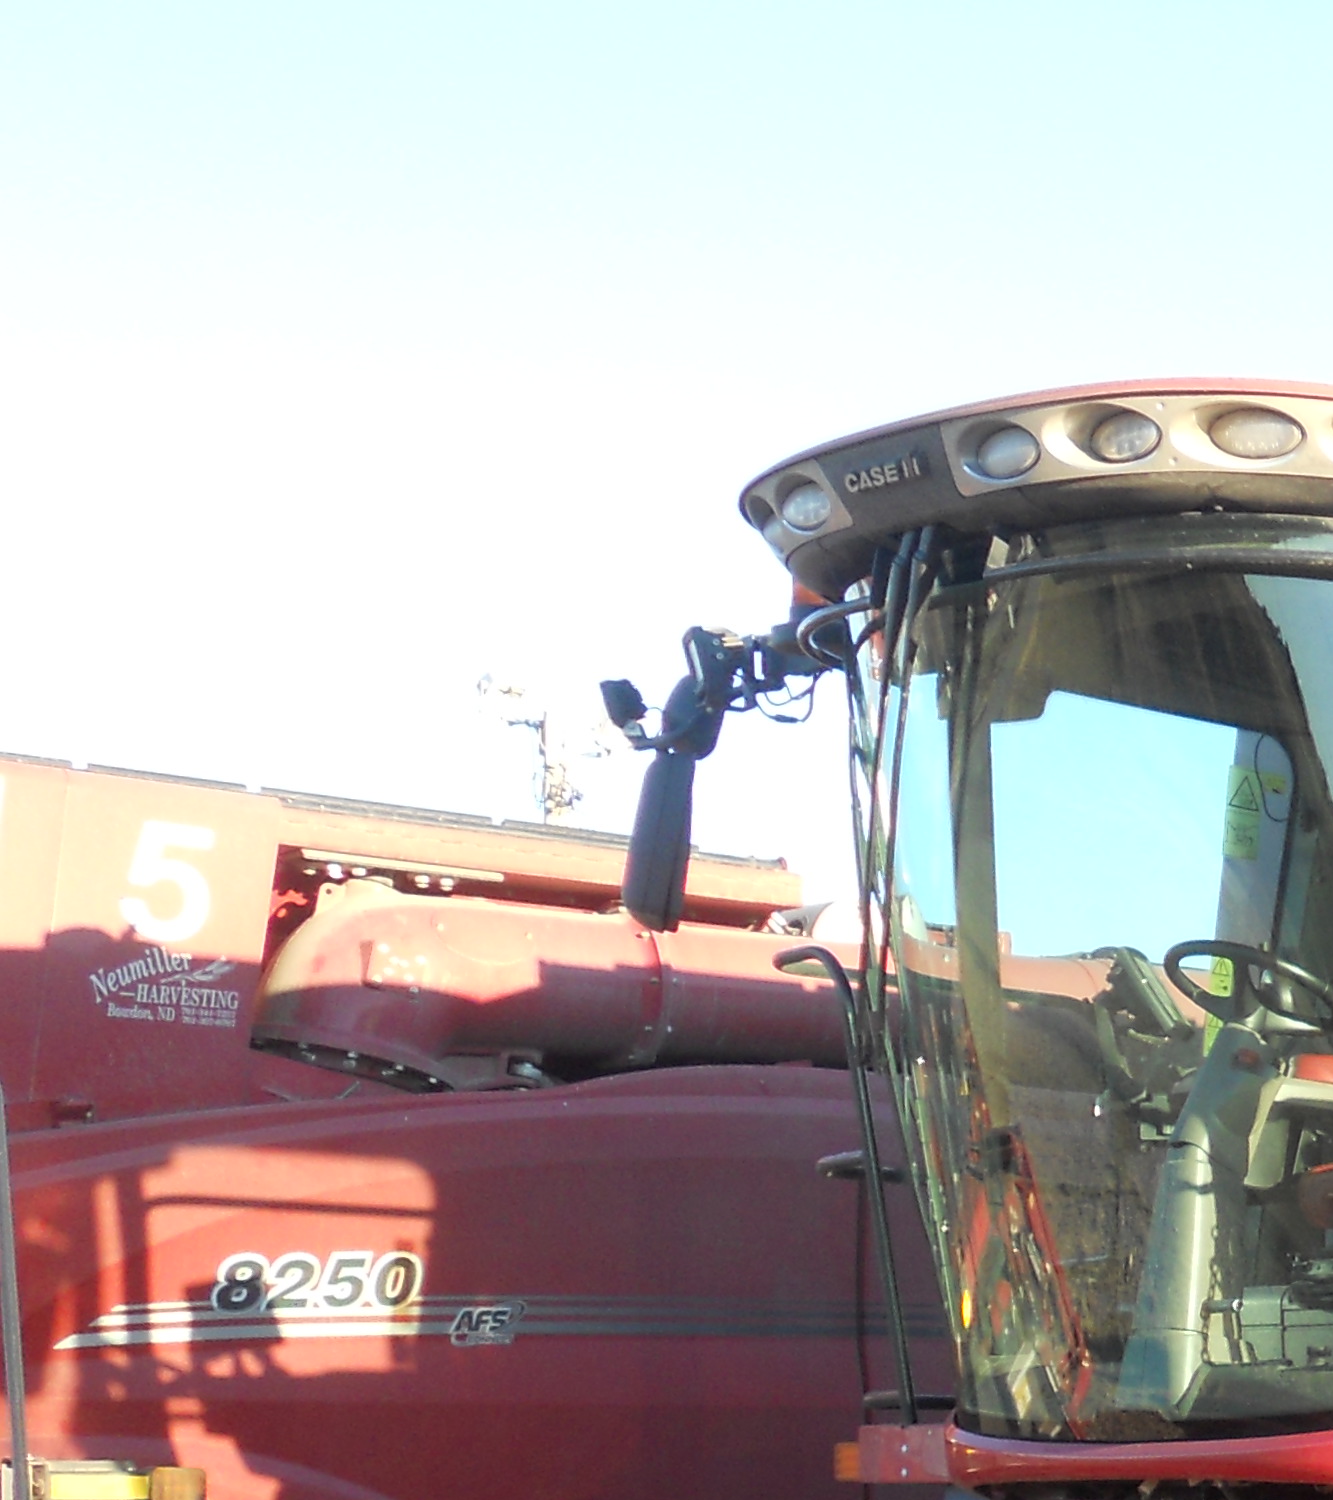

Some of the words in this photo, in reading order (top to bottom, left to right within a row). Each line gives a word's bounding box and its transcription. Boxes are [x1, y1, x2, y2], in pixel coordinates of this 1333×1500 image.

[844, 465, 899, 493] CASE
[118, 819, 216, 942] 5
[89, 946, 192, 1004] Neumiller
[136, 983, 239, 1010] HARVESTING
[157, 1007, 176, 1022] ND
[211, 1250, 425, 1315] 8250
[450, 1306, 514, 1334] AFS
